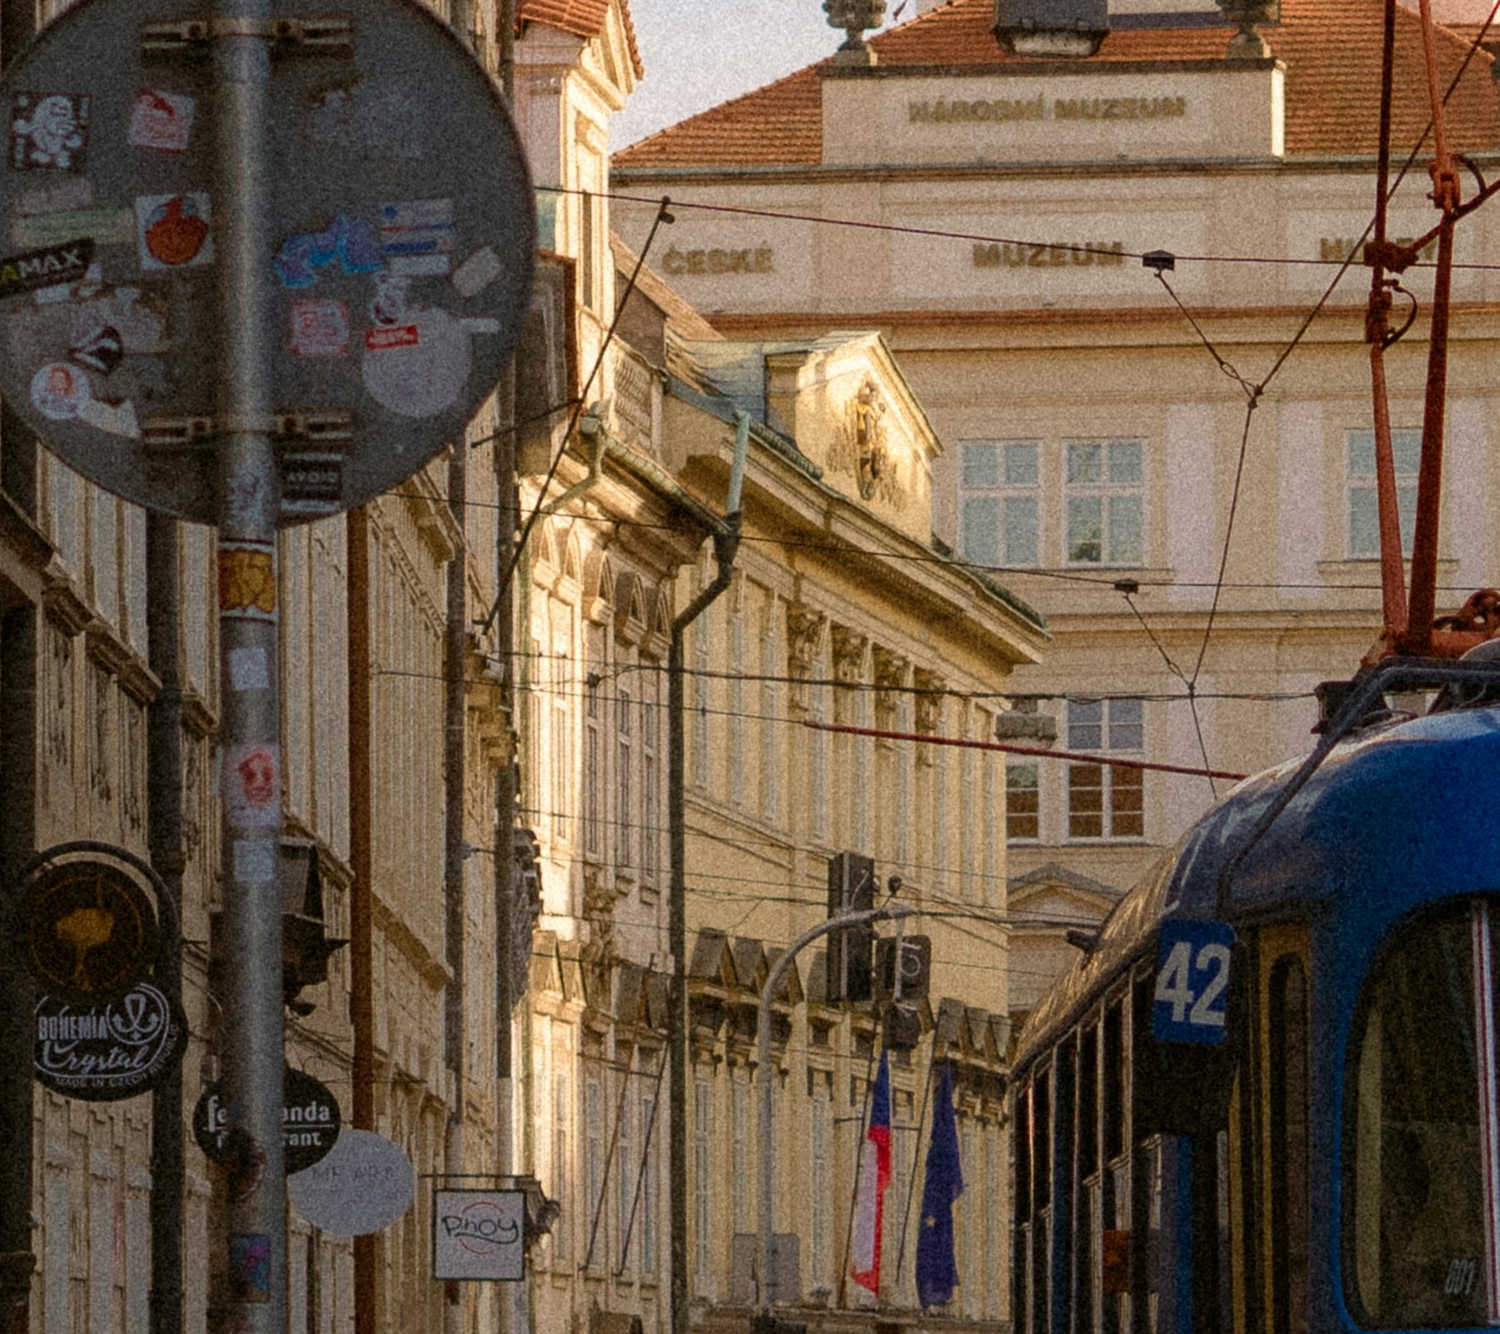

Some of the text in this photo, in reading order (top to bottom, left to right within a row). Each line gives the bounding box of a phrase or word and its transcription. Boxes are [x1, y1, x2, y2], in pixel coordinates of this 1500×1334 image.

[908, 93, 1187, 123] NÁRODNÍ MUZEUM
[662, 240, 773, 276] ČESKÉ
[972, 239, 1125, 269] MUZEUM
[1153, 941, 1231, 1029] 42
